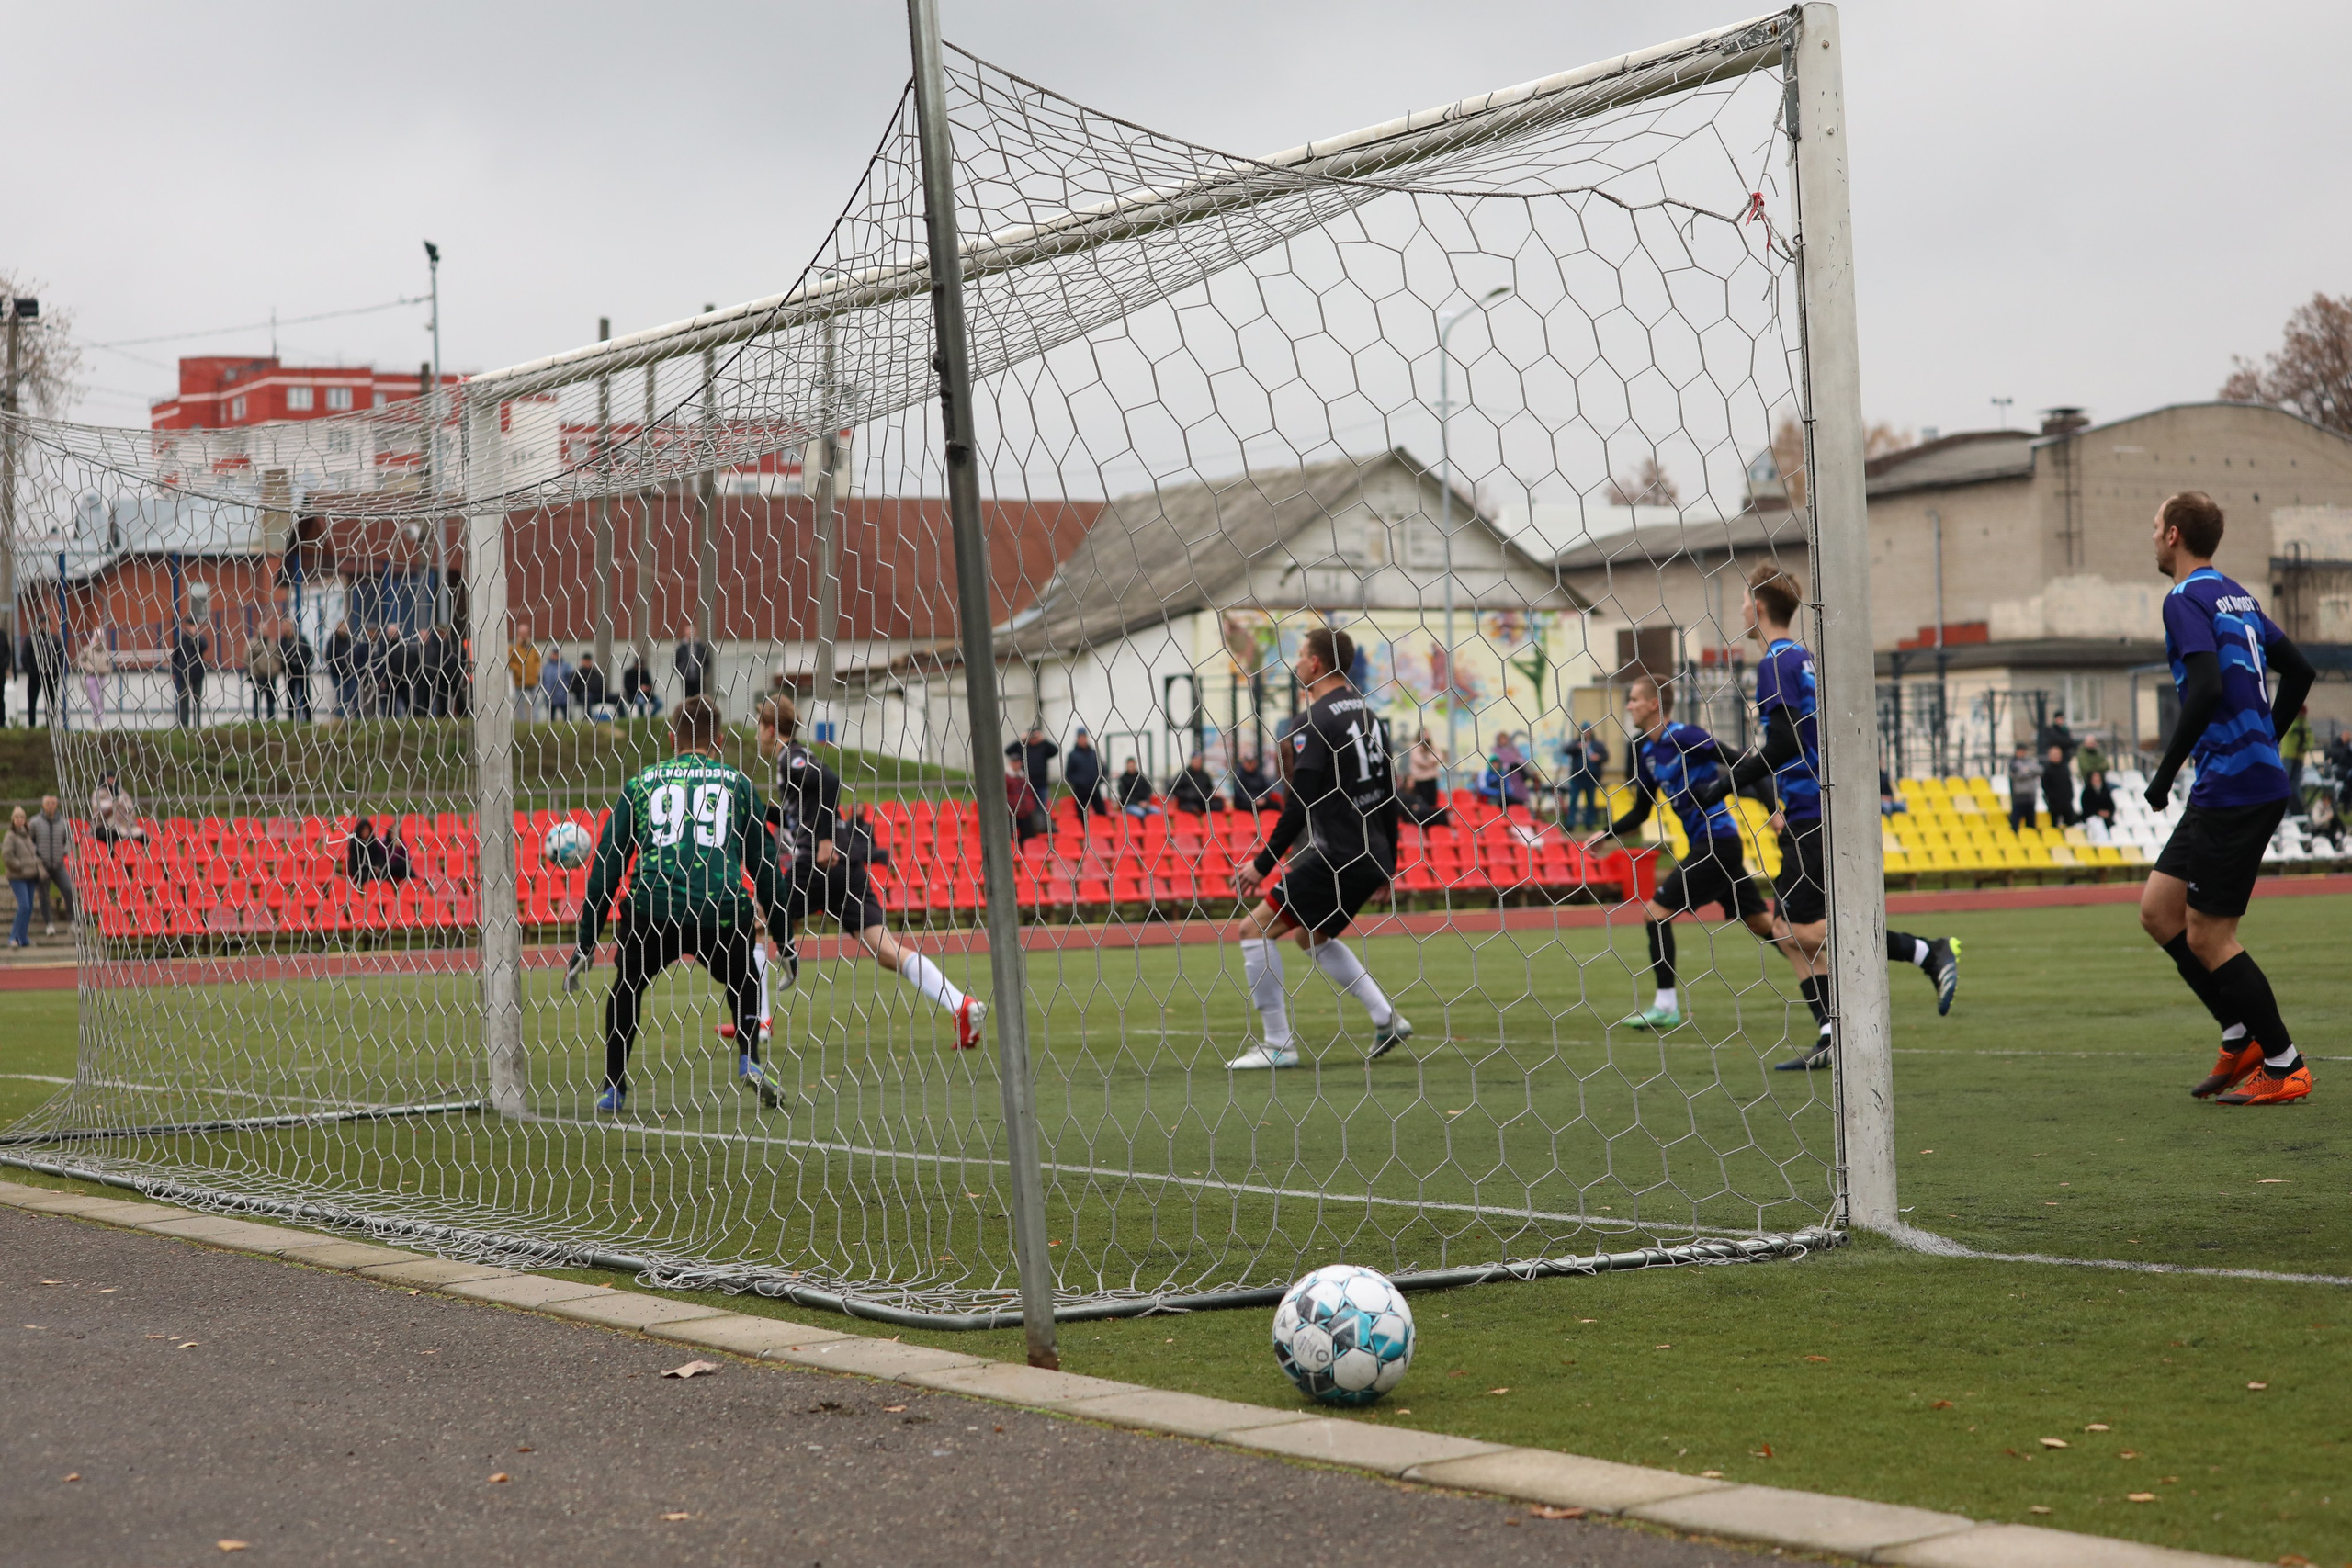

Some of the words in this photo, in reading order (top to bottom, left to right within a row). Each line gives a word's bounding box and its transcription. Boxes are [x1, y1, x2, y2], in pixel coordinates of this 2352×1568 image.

[2245, 624, 2268, 704] 9
[644, 769, 663, 783] ФК
[666, 768, 738, 782] КОМПОЗИТ
[650, 783, 729, 848] 99
